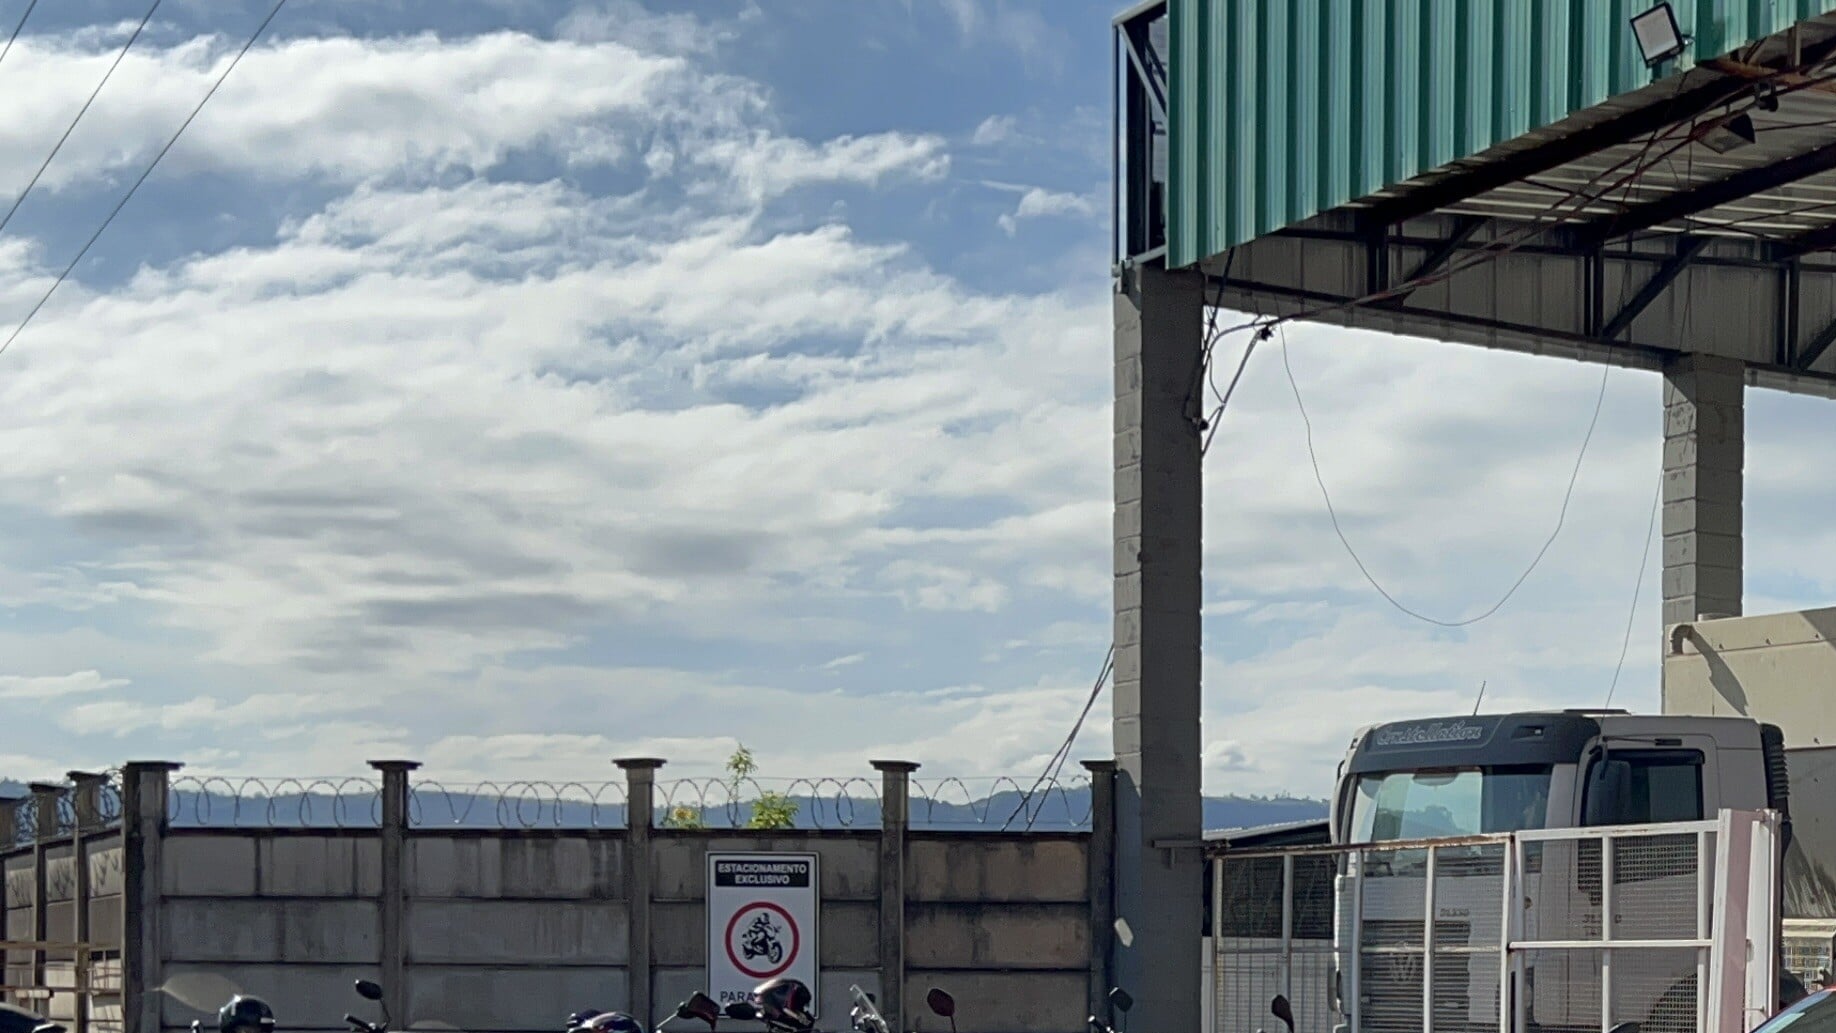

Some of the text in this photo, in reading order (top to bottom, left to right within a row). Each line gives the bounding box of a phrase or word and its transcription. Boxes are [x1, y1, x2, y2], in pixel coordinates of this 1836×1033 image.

[717, 863, 807, 874] ESTACIONAMENTO
[734, 874, 790, 885] EXCLUSIVO
[719, 990, 755, 1002] PARA
